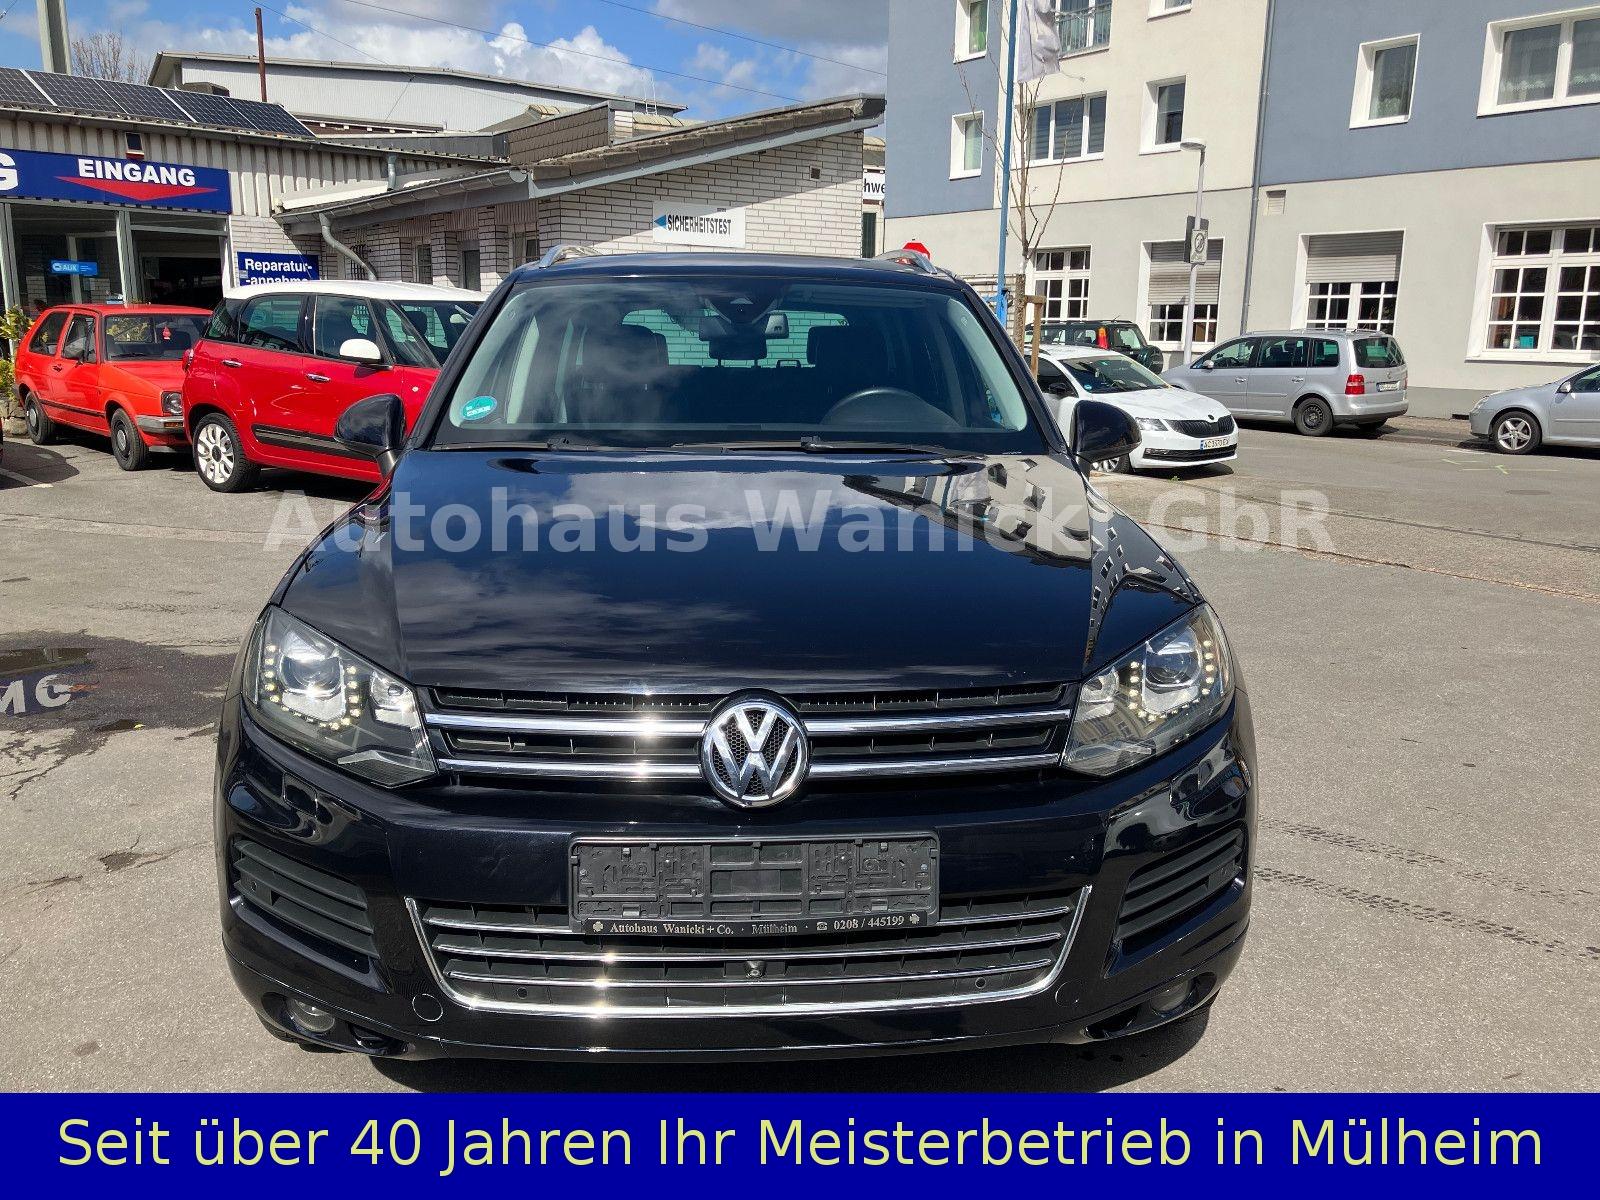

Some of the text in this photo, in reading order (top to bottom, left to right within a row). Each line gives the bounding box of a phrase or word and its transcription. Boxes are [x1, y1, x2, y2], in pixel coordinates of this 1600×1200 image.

[78, 158, 196, 187] EINGANG
[667, 214, 732, 236] SICHERHEITSTEST
[244, 258, 313, 273] Reparatur-
[610, 923, 658, 933] Autohaus
[663, 923, 705, 934] Wanicki
[751, 924, 798, 935] Mülheim
[833, 919, 859, 930] 0208
[868, 915, 905, 927] 445199
